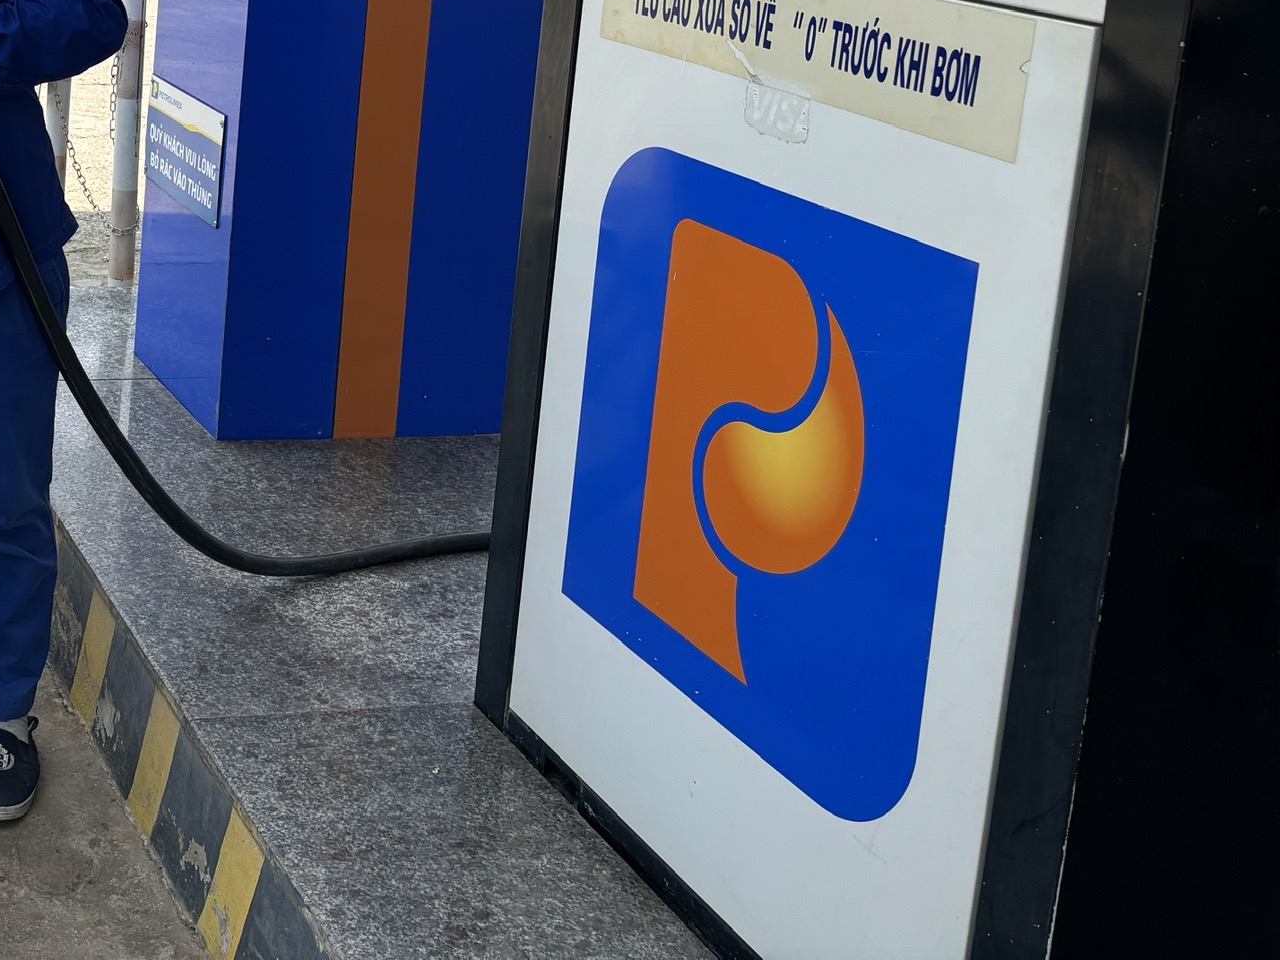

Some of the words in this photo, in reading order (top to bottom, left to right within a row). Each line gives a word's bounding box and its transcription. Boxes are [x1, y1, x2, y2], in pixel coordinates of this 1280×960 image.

[830, 17, 892, 83] TRƯỚC
[893, 37, 929, 94] KHI
[930, 45, 982, 107] BƠM
[150, 150, 159, 170] BỎ
[160, 158, 172, 180] RÁC
[173, 168, 186, 191] VÀO
[187, 179, 212, 209] THÙNG
[163, 135, 184, 159] KHÁCH
[185, 146, 197, 169] VUI
[198, 155, 216, 181] LÒNG
